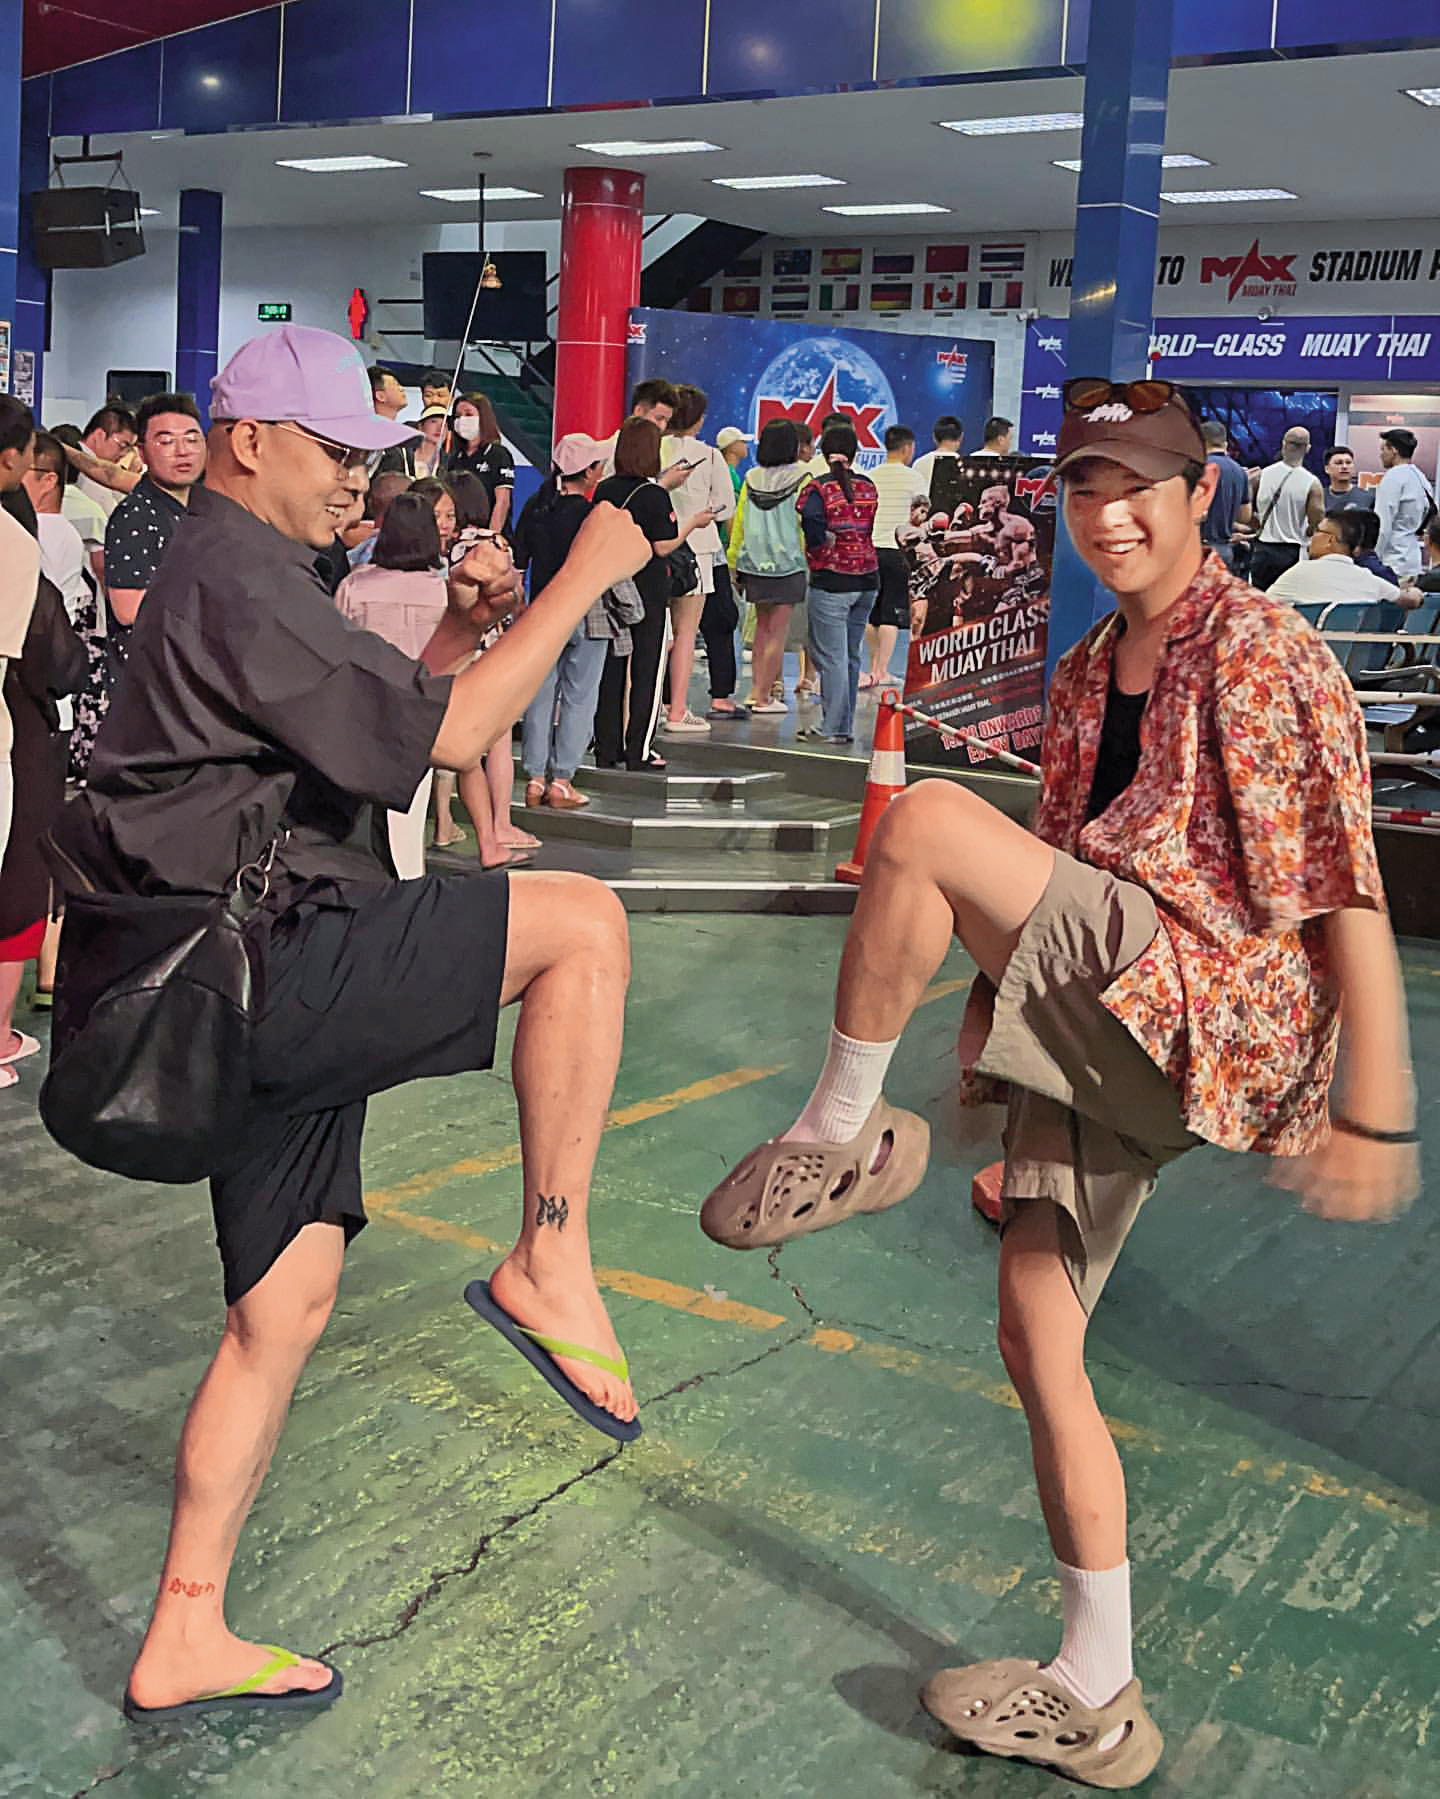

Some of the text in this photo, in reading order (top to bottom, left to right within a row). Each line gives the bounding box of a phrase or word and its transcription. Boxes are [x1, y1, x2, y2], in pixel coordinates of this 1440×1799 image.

[1157, 255, 1185, 285] TO
[1200, 237, 1298, 304] MAX
[1309, 249, 1423, 282] STADIUM
[1242, 284, 1297, 297] MUAY THAI
[1149, 333, 1432, 357] RLD-CLASS MUAY THAI
[1014, 471, 1057, 512] MA
[919, 622, 986, 665] WORLD
[930, 646, 988, 686] MUAY
[989, 630, 1036, 665] THAI
